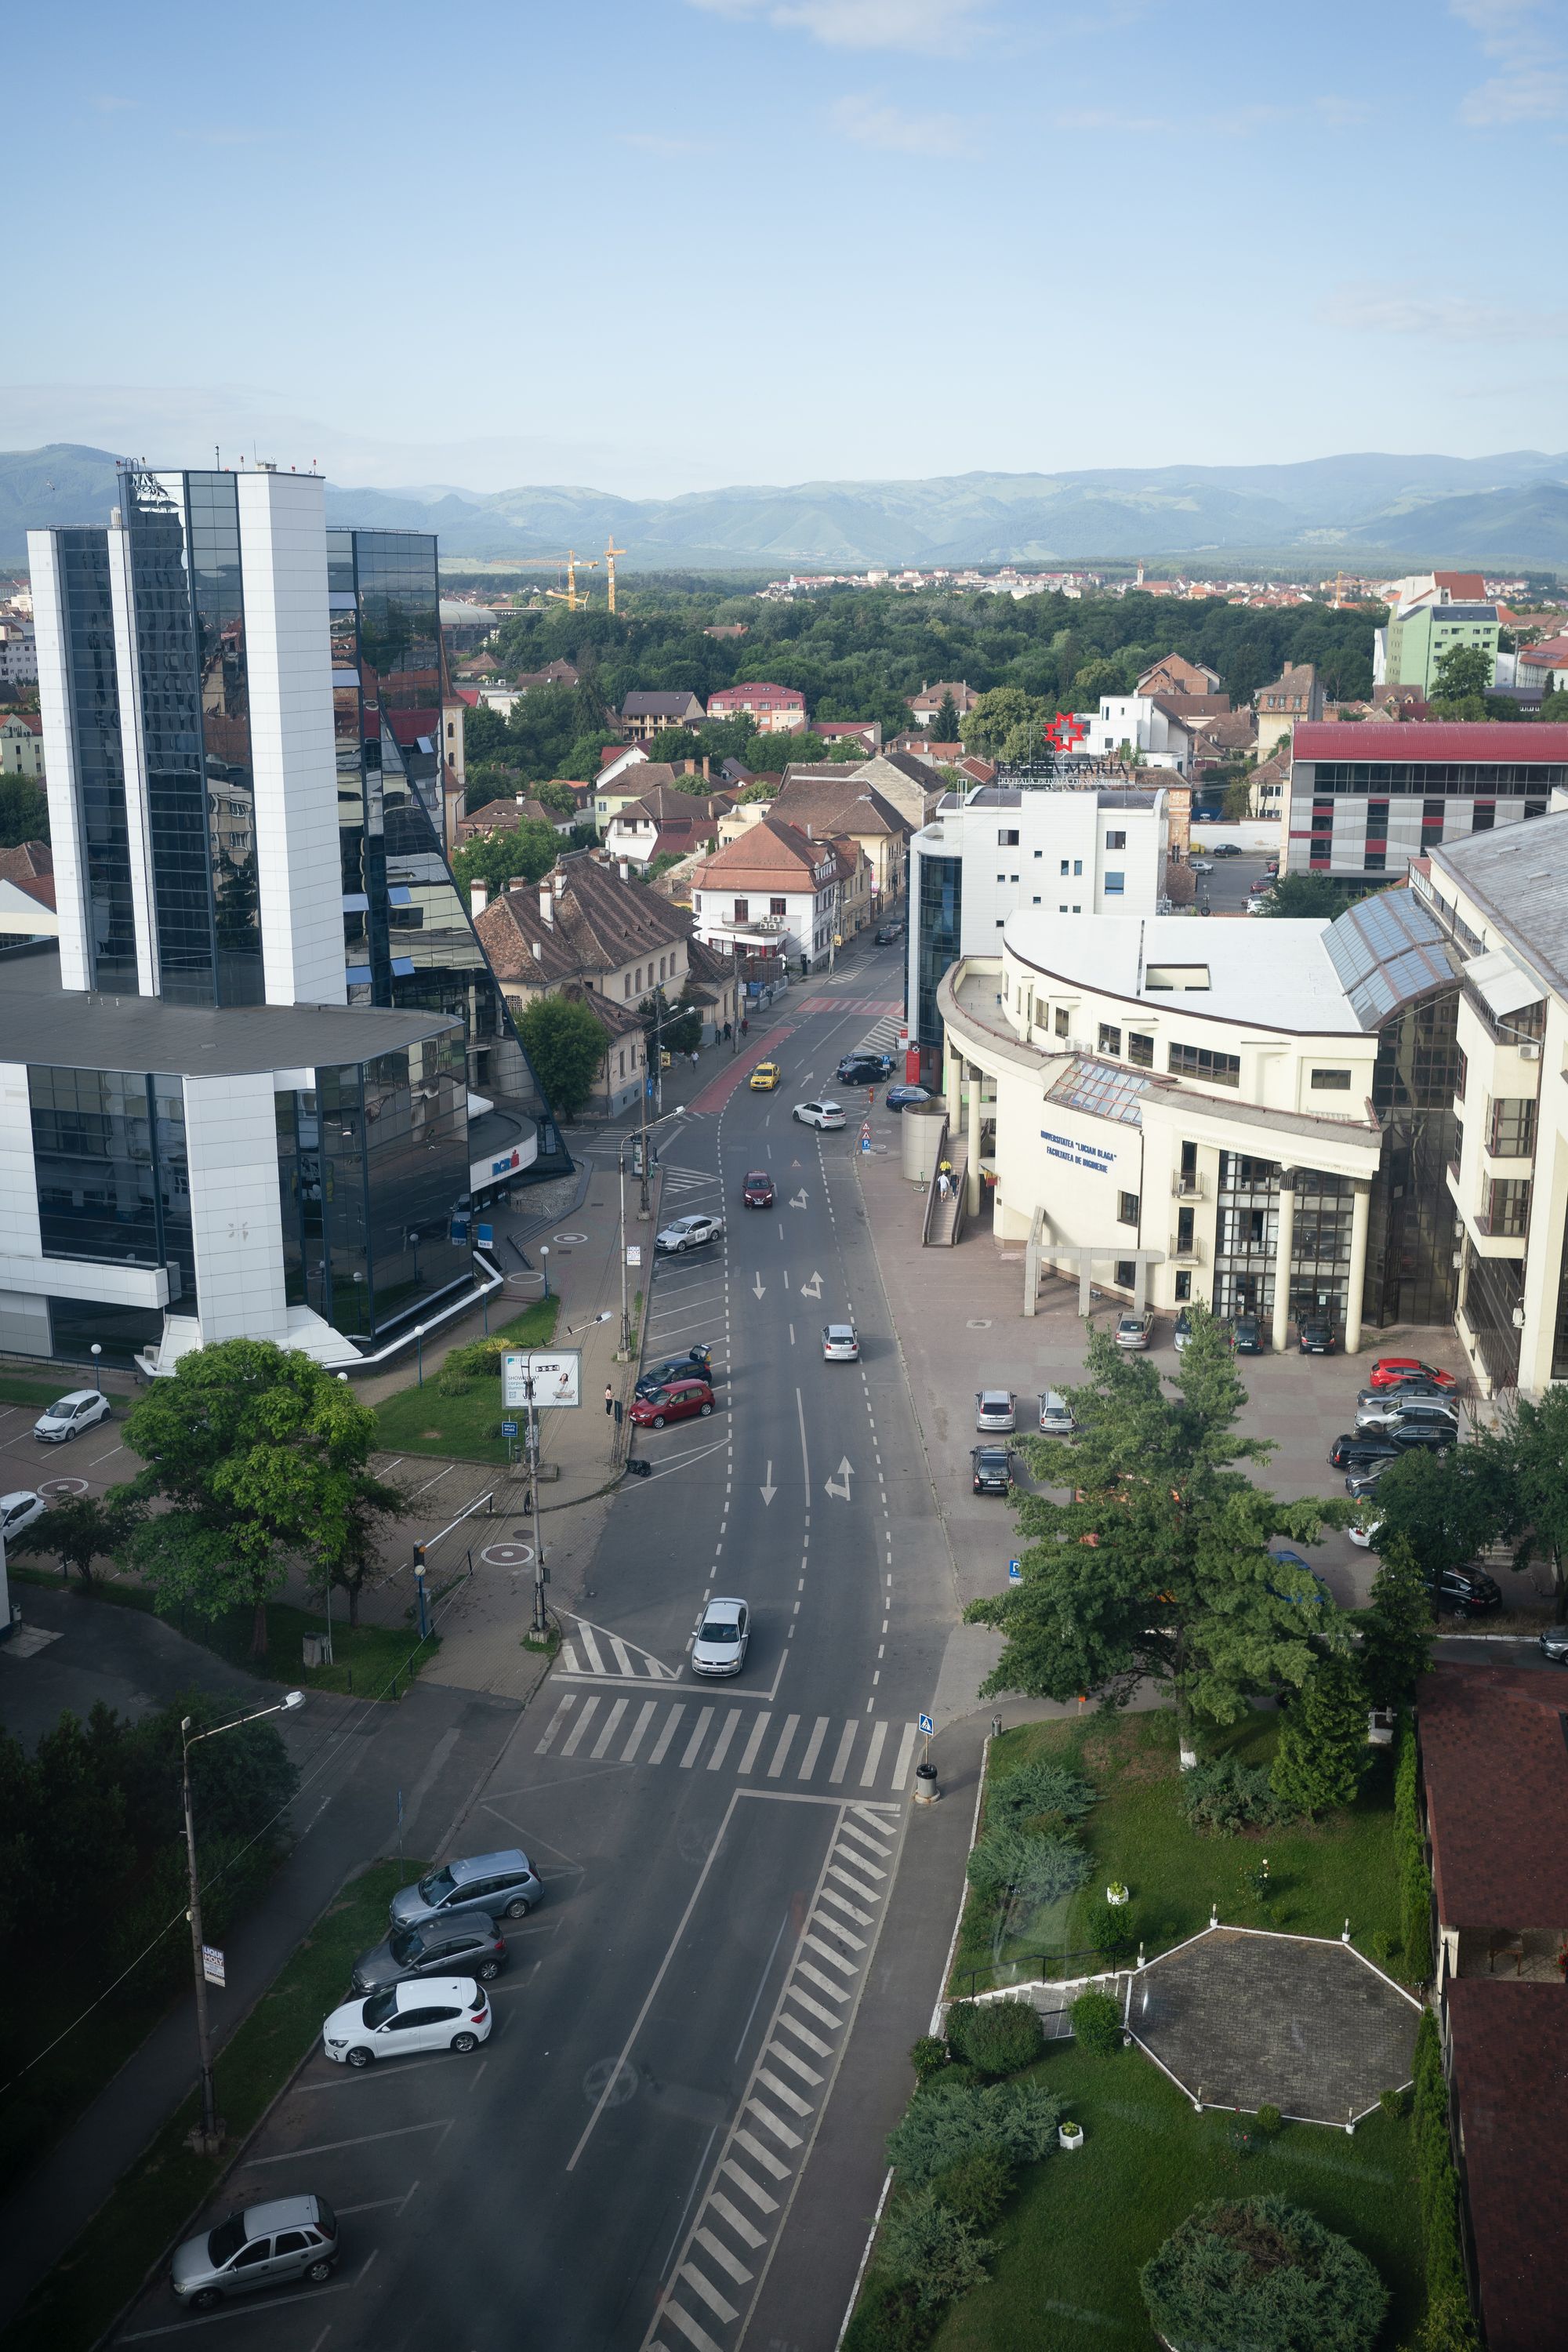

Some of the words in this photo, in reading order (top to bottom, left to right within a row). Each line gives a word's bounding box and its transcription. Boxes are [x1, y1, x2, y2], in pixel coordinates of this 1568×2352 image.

[997, 761, 1062, 775] REGINA
[1065, 760, 1128, 775] MARIA
[1040, 1130, 1074, 1149] UNIVERSITATEA
[492, 1157, 511, 1176] BCR
[1047, 1145, 1074, 1163] FACULTATEA
[1075, 1156, 1082, 1165] DE
[1083, 1158, 1109, 1174] INGINERIE
[204, 1946, 222, 1959] LIQUI
[205, 1954, 223, 1965] MOLY
